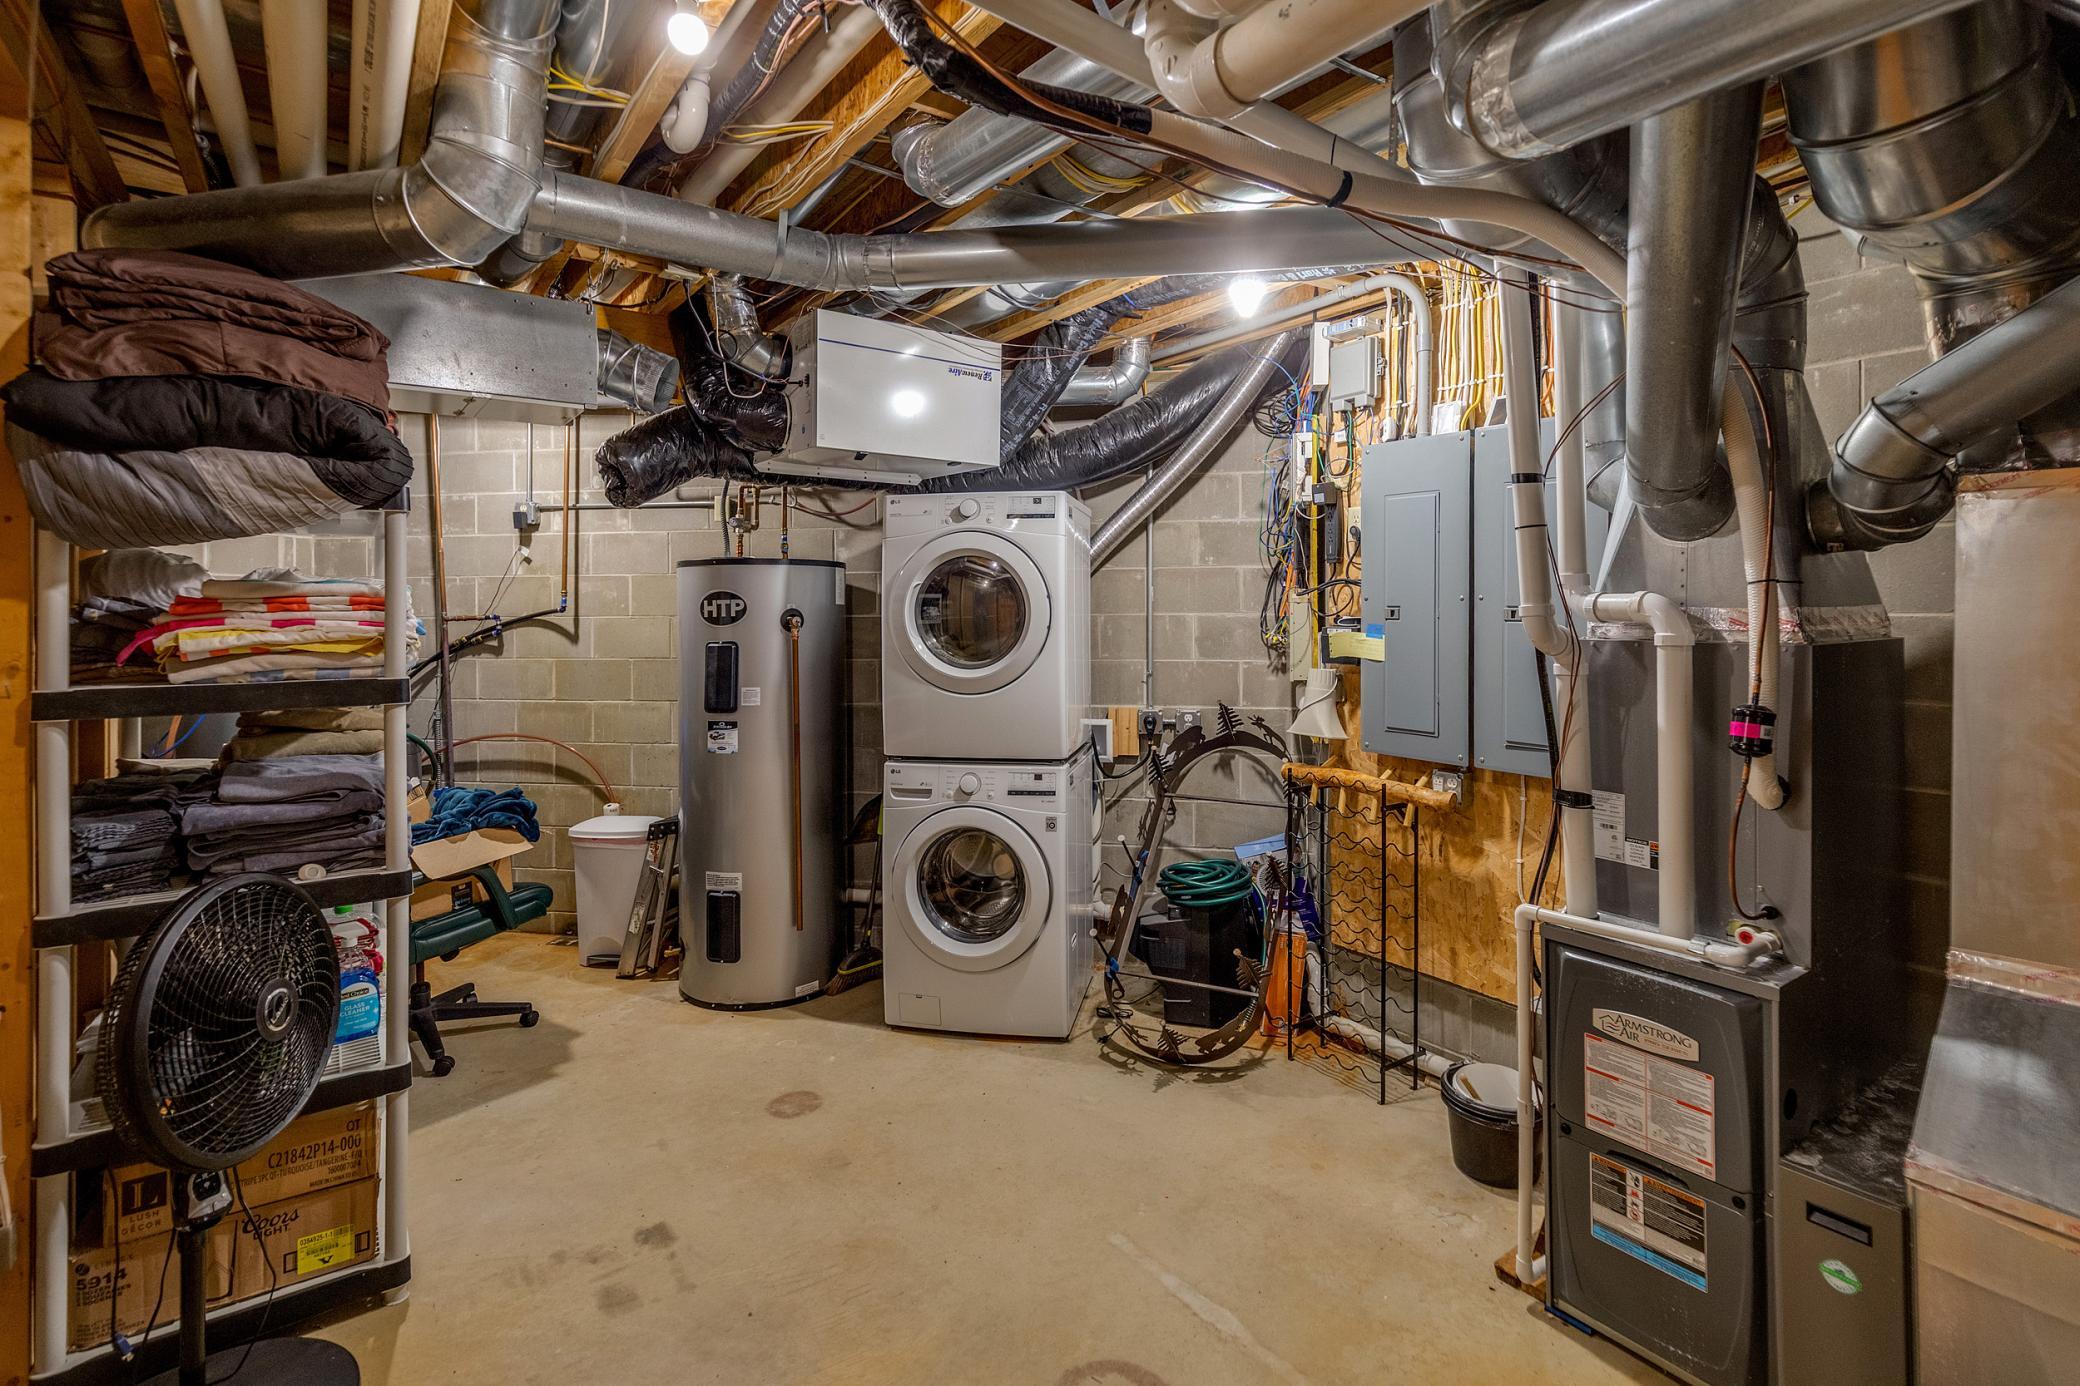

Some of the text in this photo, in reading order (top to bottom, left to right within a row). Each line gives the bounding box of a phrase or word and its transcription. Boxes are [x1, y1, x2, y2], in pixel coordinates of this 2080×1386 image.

[947, 367, 983, 381] RenewAire
[703, 599, 744, 617] HTP
[340, 1006, 370, 1017] CLEANER
[345, 1002, 365, 1010] GLASS
[1615, 1014, 1692, 1049] ARMSTRONG
[1619, 1028, 1640, 1043] AIR
[346, 1119, 360, 1131] QT
[268, 1134, 361, 1169] C21842P14-000
[129, 1209, 159, 1223] LUSH
[242, 1208, 299, 1234] Coors
[253, 1224, 290, 1240] LIGHT
[76, 1268, 127, 1290] 5914
